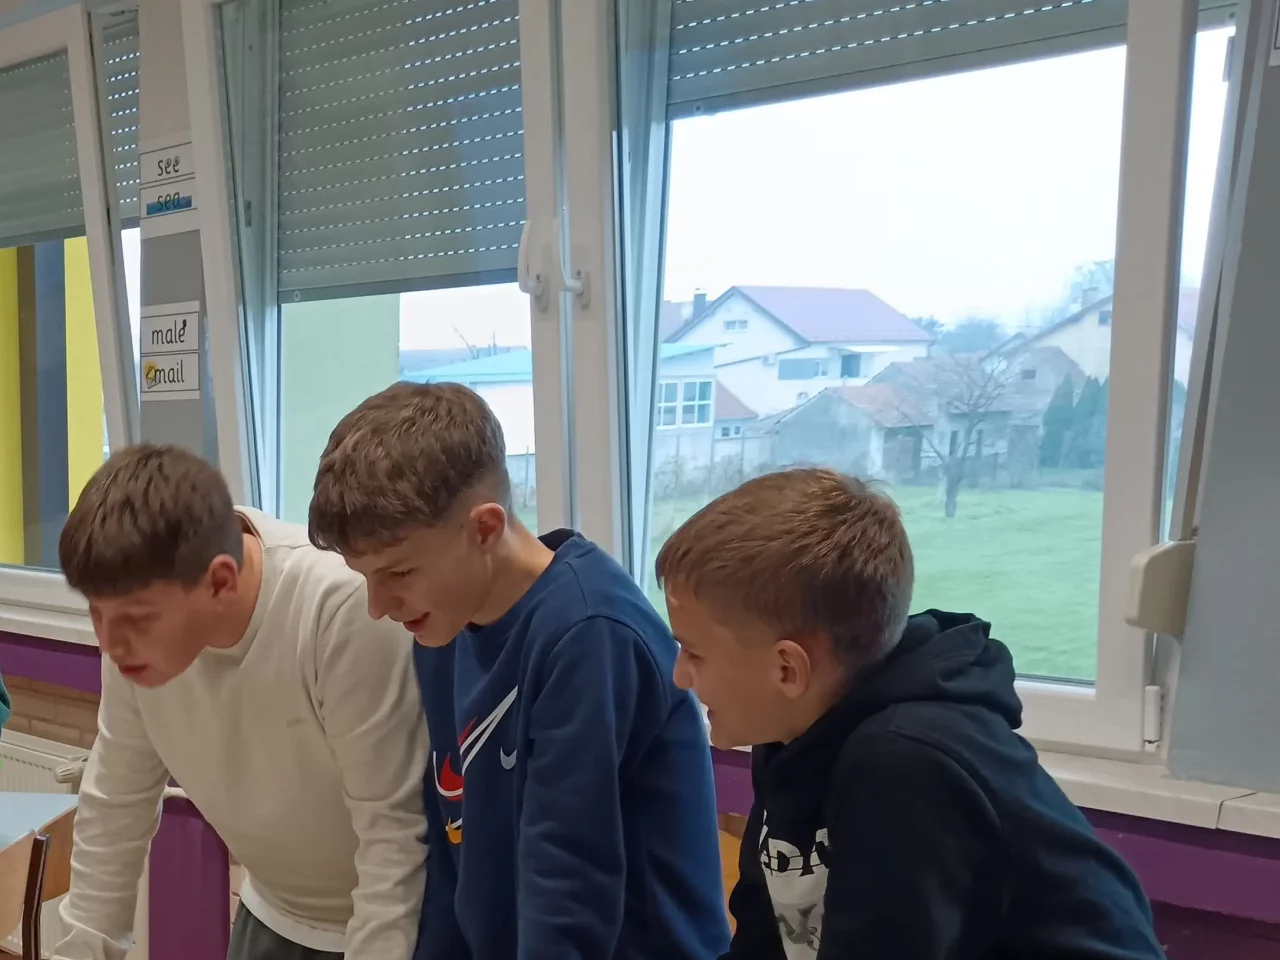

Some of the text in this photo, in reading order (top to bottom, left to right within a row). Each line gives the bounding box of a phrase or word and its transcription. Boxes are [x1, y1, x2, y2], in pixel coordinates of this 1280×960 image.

[157, 155, 180, 177] see
[157, 191, 180, 212] sea
[151, 319, 187, 345] male
[154, 359, 185, 385] mail
